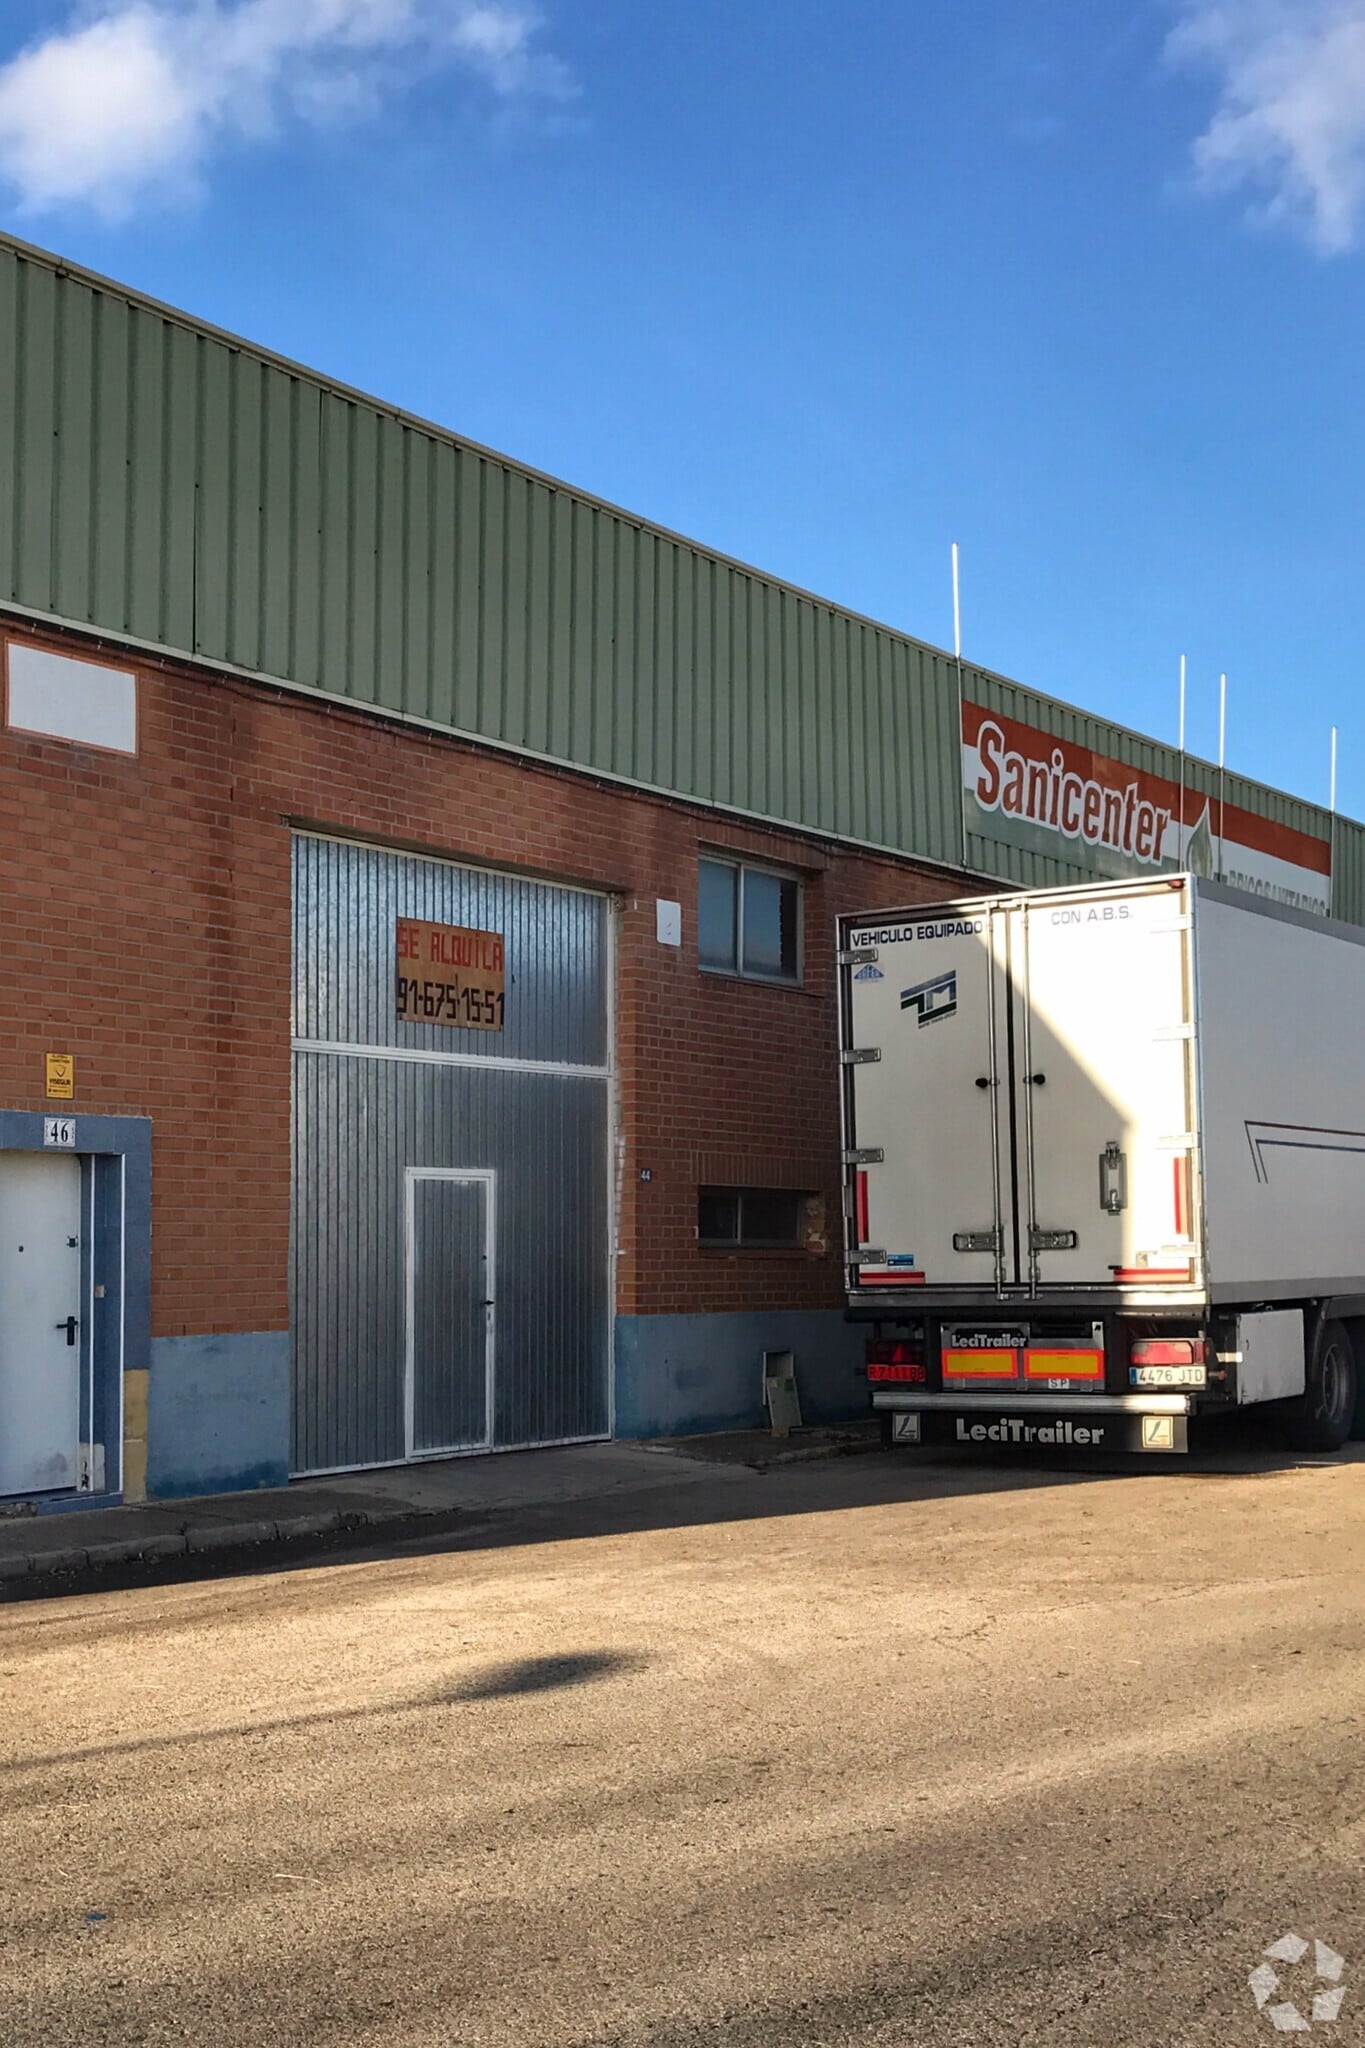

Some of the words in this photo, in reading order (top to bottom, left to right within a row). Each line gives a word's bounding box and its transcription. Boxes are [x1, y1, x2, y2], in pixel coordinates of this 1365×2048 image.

[976, 721, 1170, 865] Sanicenter
[1051, 910, 1081, 926] CON
[1087, 905, 1133, 922] A.B.S.
[852, 928, 913, 947] VEHICULO
[917, 921, 983, 941] EQUIPADO
[396, 924, 420, 959] SE
[431, 931, 503, 972] ALQUILA
[50, 1121, 69, 1143] 46
[641, 1169, 651, 1181] 44
[951, 1332, 1027, 1348] LeciTrailer
[1139, 1369, 1173, 1382] 4476
[1178, 1369, 1204, 1382] JTD
[956, 1418, 1105, 1445] LeciTrailer
